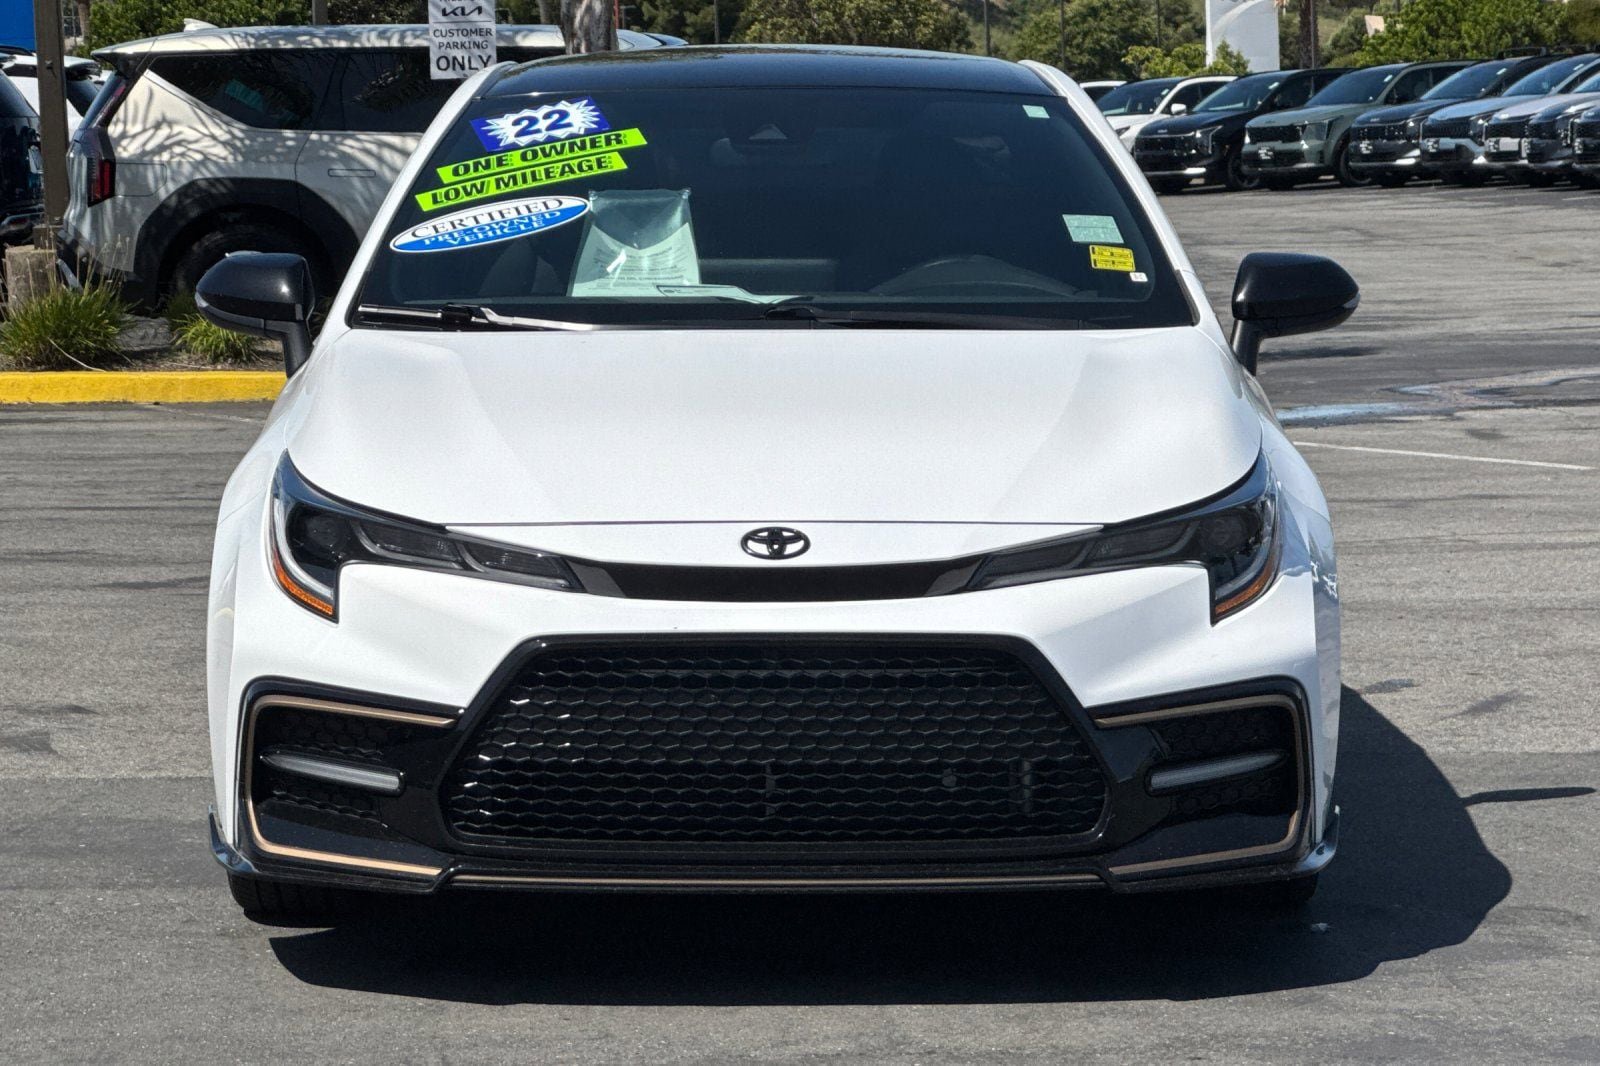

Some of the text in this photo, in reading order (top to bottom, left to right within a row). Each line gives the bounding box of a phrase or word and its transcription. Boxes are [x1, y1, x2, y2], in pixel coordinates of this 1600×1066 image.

[442, 6, 482, 16] KIA
[433, 28, 493, 37] CUSTOMER
[438, 40, 489, 50] PARKING
[436, 54, 491, 71] ONLY
[511, 109, 573, 138] 22
[451, 132, 627, 177] ONE OWNER
[431, 155, 612, 205] LOW MILEAGE
[411, 198, 563, 238] CERTIFIED
[423, 211, 561, 245] PRE-OWNED
[446, 221, 545, 246] VEHICLE
